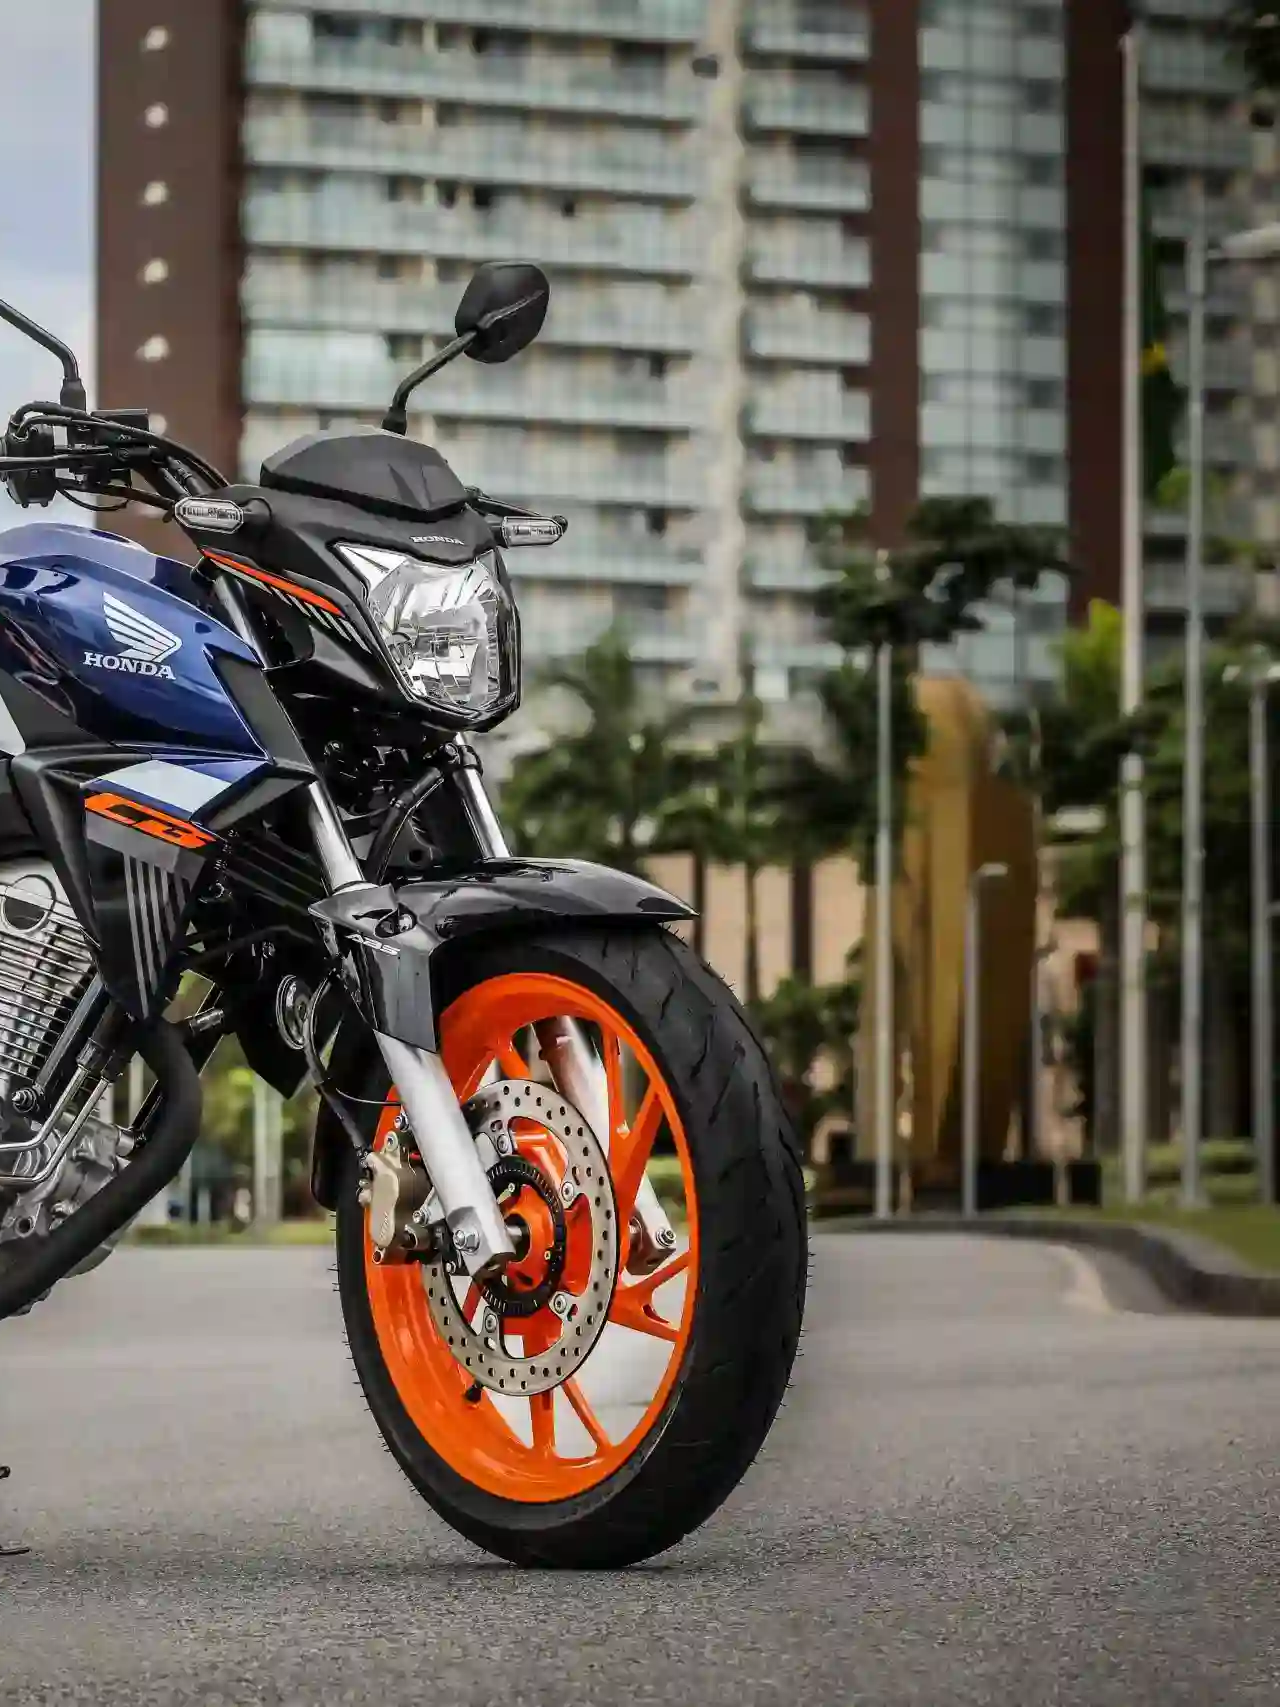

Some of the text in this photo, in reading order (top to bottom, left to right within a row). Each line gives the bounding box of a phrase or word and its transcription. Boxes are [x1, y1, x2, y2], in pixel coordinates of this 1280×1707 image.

[411, 536, 465, 545] HONDA
[83, 652, 176, 680] HONDA
[85, 792, 217, 849] CB
[345, 934, 400, 956] ABS
